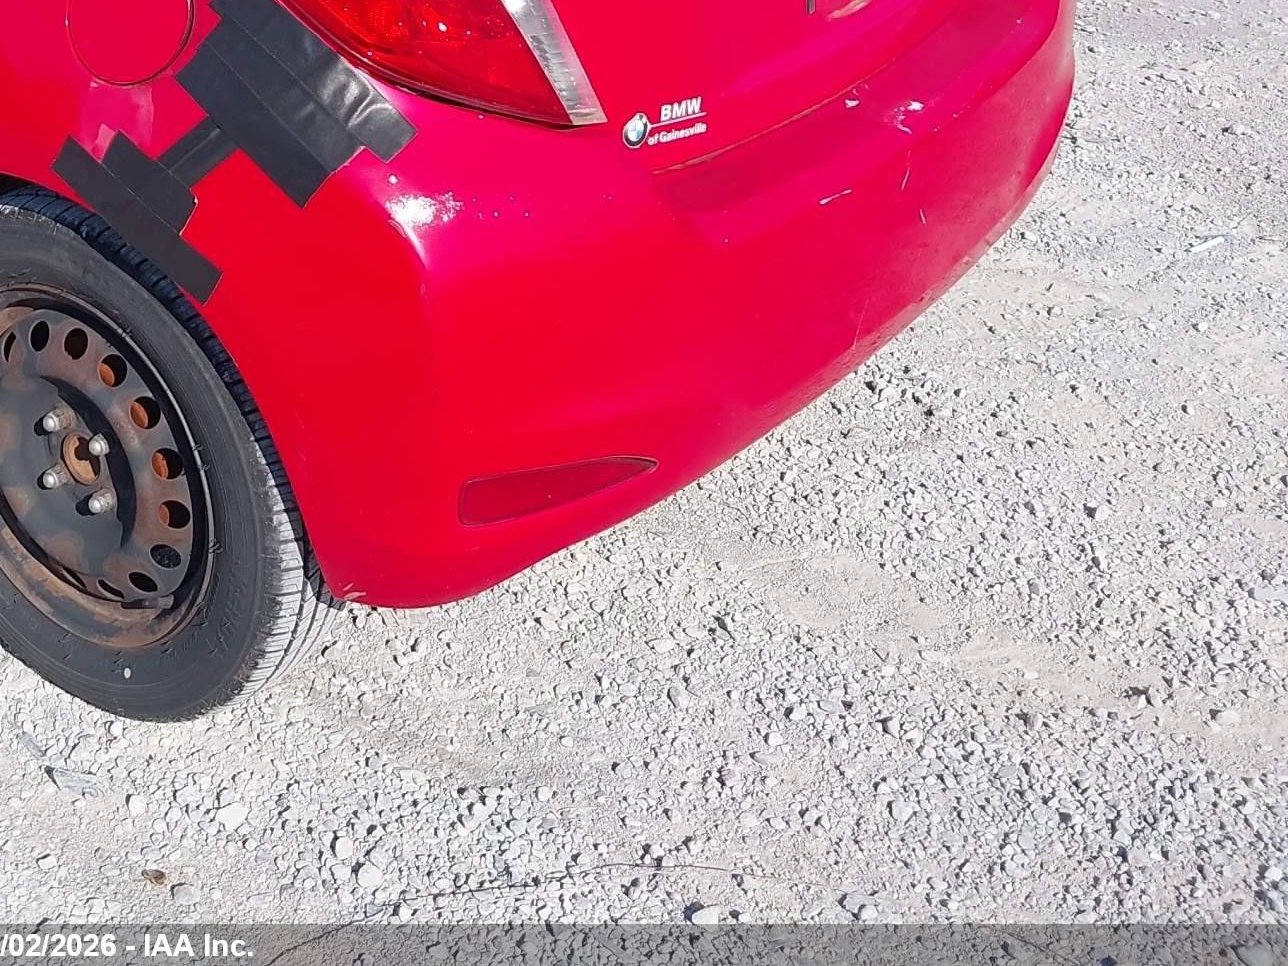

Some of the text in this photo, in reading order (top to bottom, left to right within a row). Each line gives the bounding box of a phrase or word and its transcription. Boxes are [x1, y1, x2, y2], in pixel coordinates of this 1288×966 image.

[660, 96, 702, 121] BMW
[648, 122, 707, 145] of Gainesville
